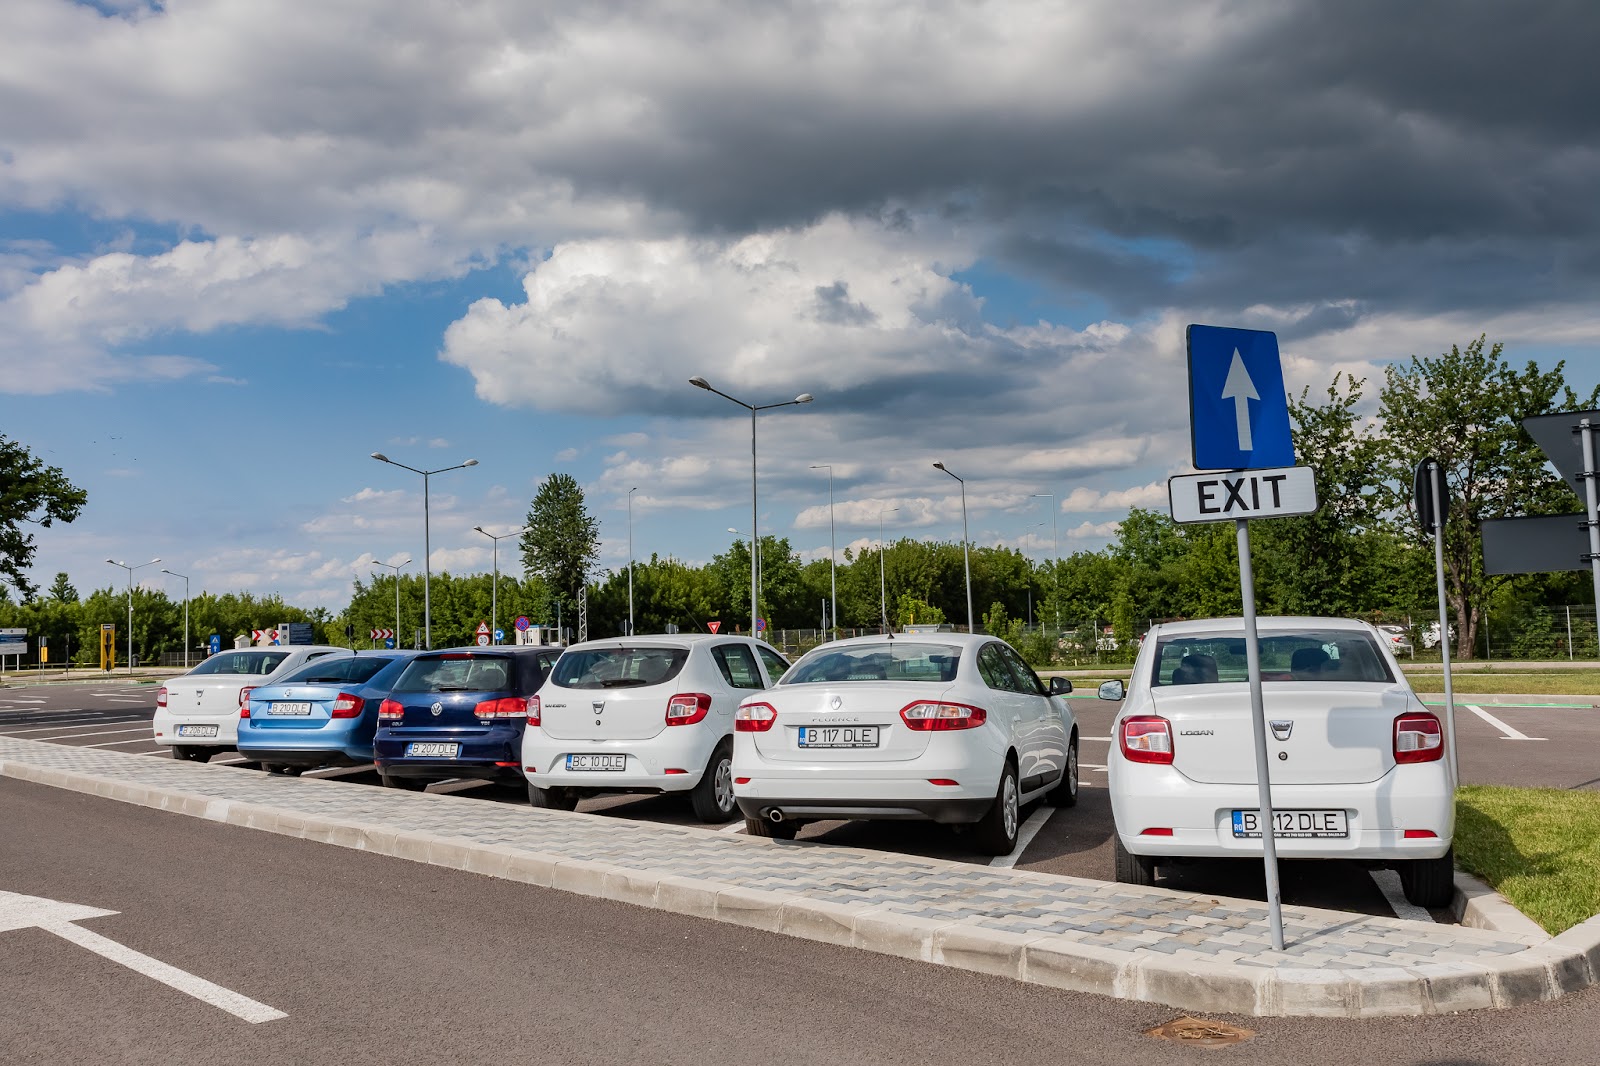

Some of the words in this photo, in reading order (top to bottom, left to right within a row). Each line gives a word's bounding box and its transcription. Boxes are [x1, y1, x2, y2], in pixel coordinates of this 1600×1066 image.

[1197, 475, 1287, 514] EXIT
[272, 704, 278, 712] B
[280, 704, 291, 712] 210
[292, 704, 307, 712] DLE
[183, 726, 188, 734] B
[202, 727, 215, 735] DLE
[808, 729, 818, 742] B
[822, 729, 839, 742] 117
[843, 729, 872, 742] DLE
[413, 744, 419, 753] B
[421, 744, 437, 753] 207
[438, 744, 457, 754] DLE
[572, 756, 587, 767] BC
[591, 756, 600, 767] 10
[602, 756, 623, 767] DLE
[1244, 813, 1257, 830] B
[1272, 813, 1294, 830] 12
[1298, 813, 1338, 831] DLE
